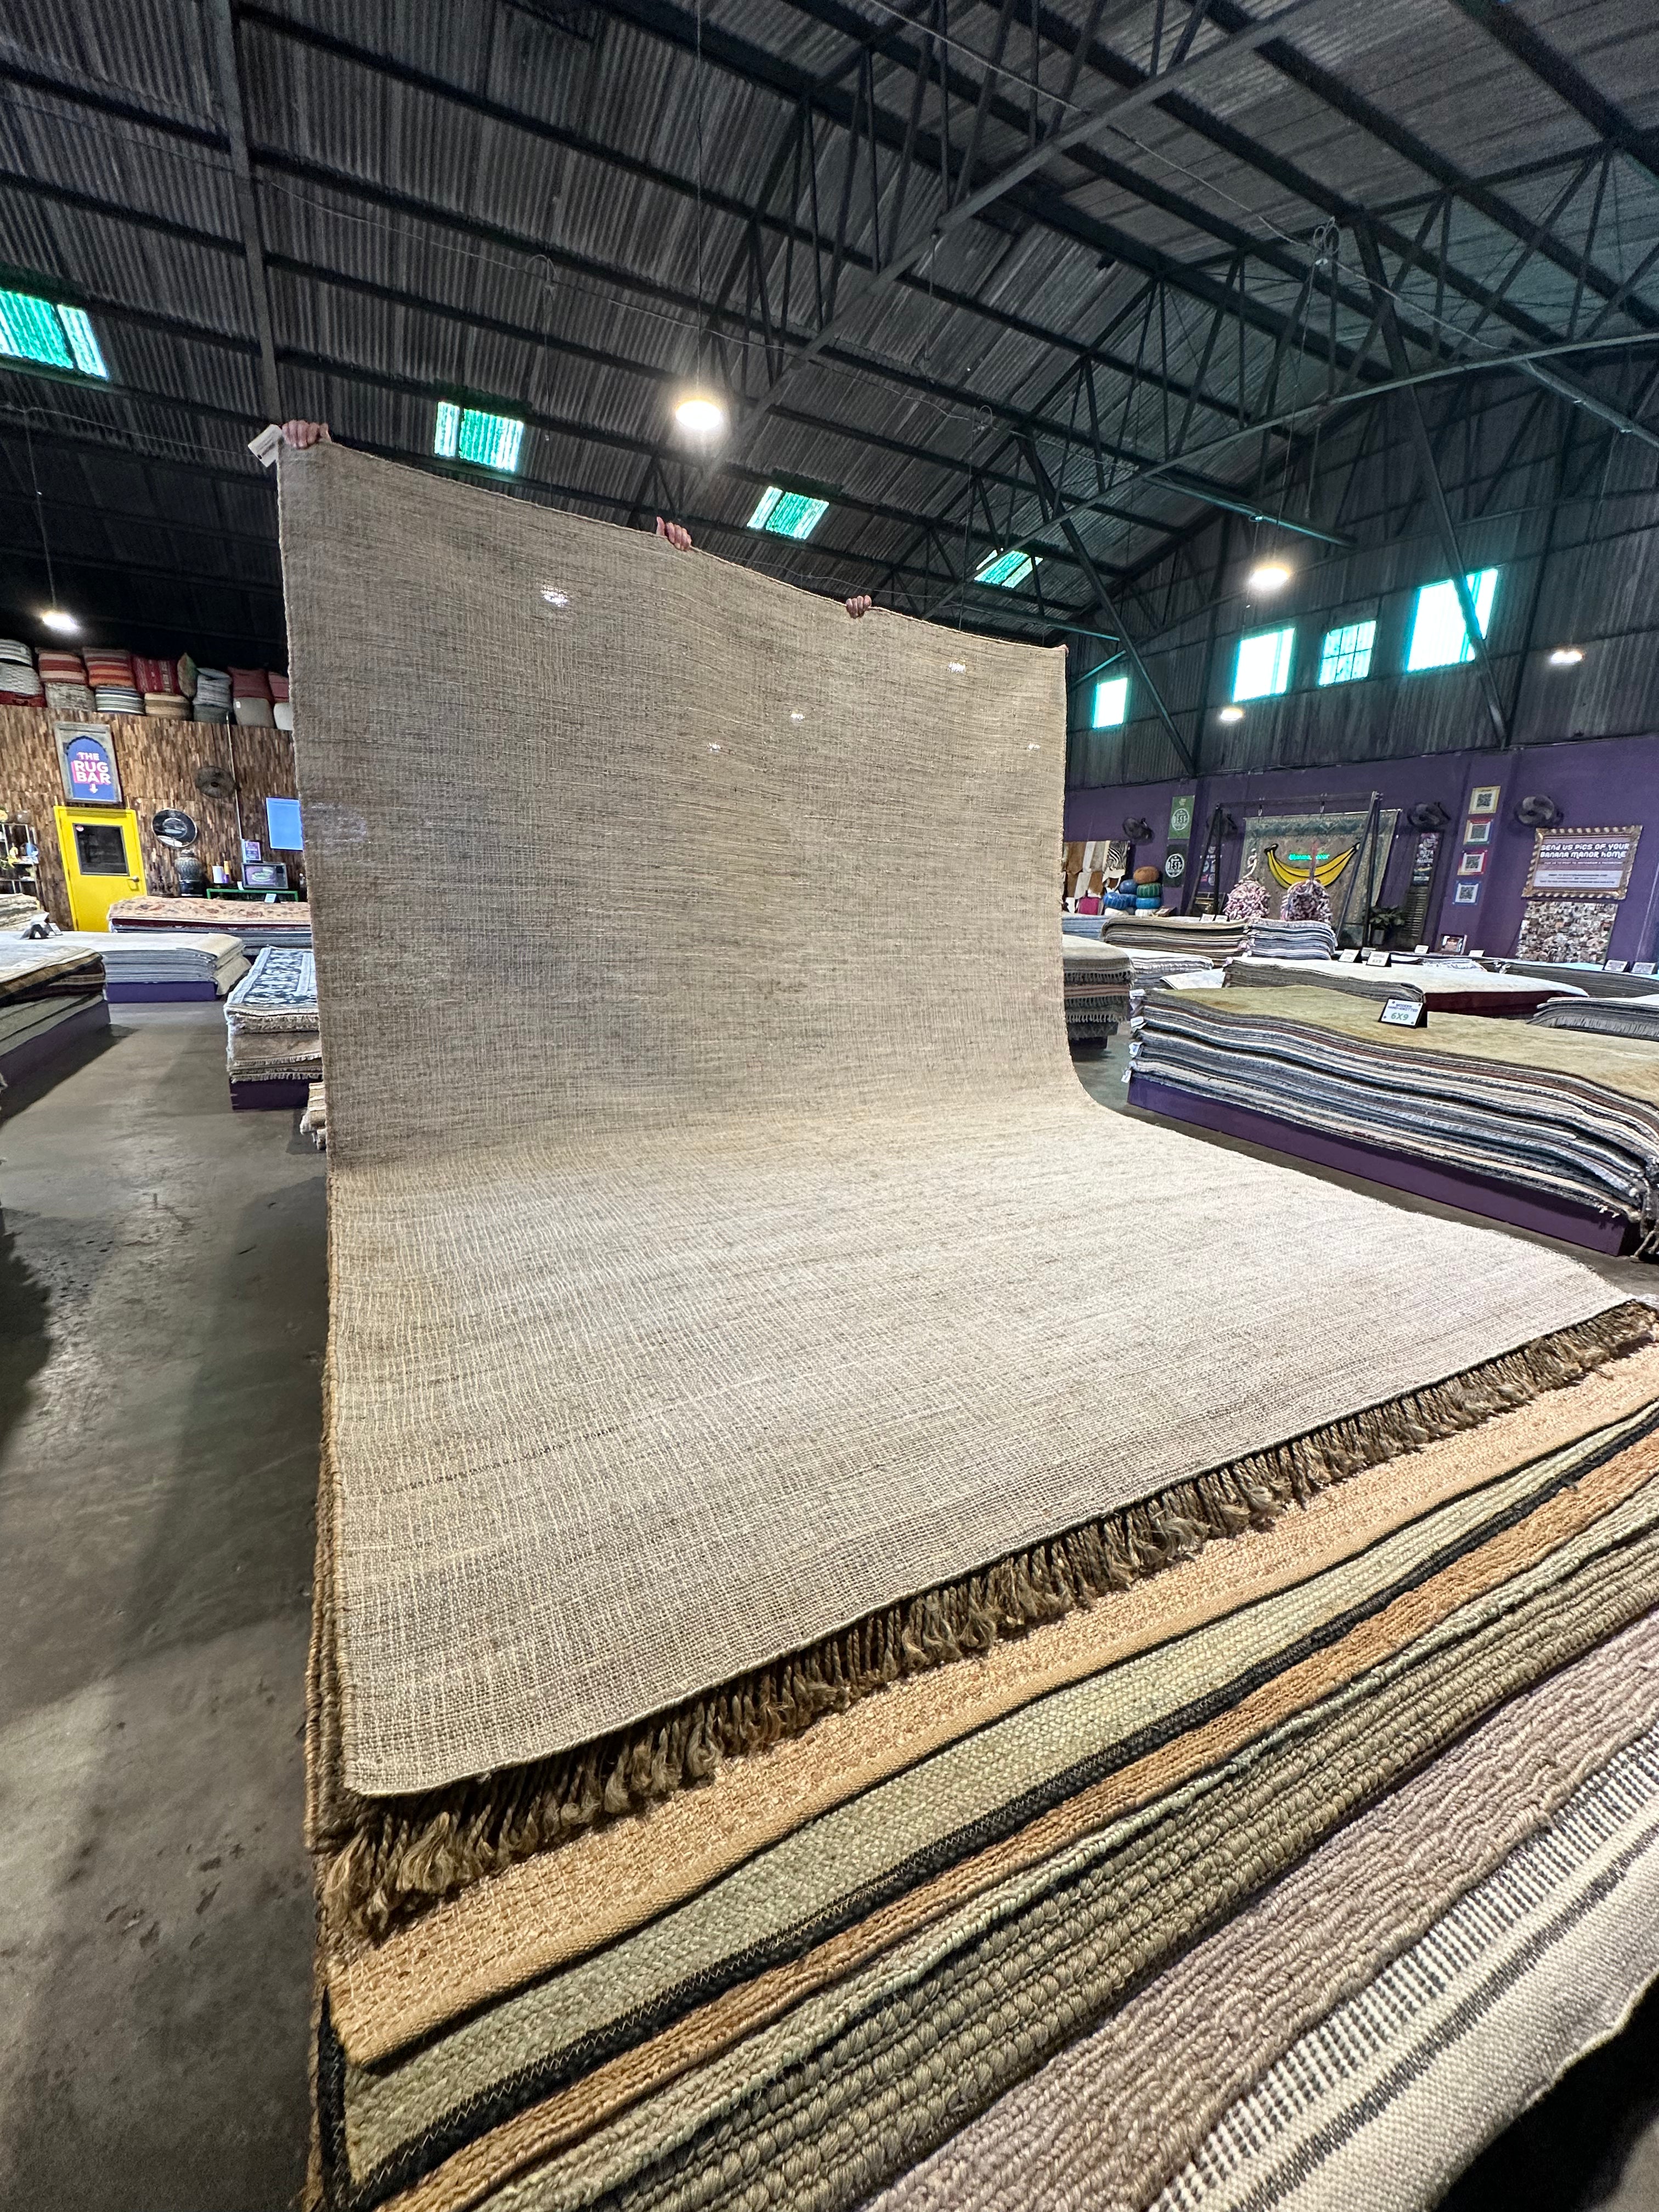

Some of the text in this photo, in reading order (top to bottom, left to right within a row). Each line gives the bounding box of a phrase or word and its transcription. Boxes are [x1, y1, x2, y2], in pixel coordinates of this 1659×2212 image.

[77, 752, 100, 761] THE
[72, 760, 109, 773] RUG
[75, 771, 111, 785] BAR
[1391, 1012, 1409, 1020] 6X9
